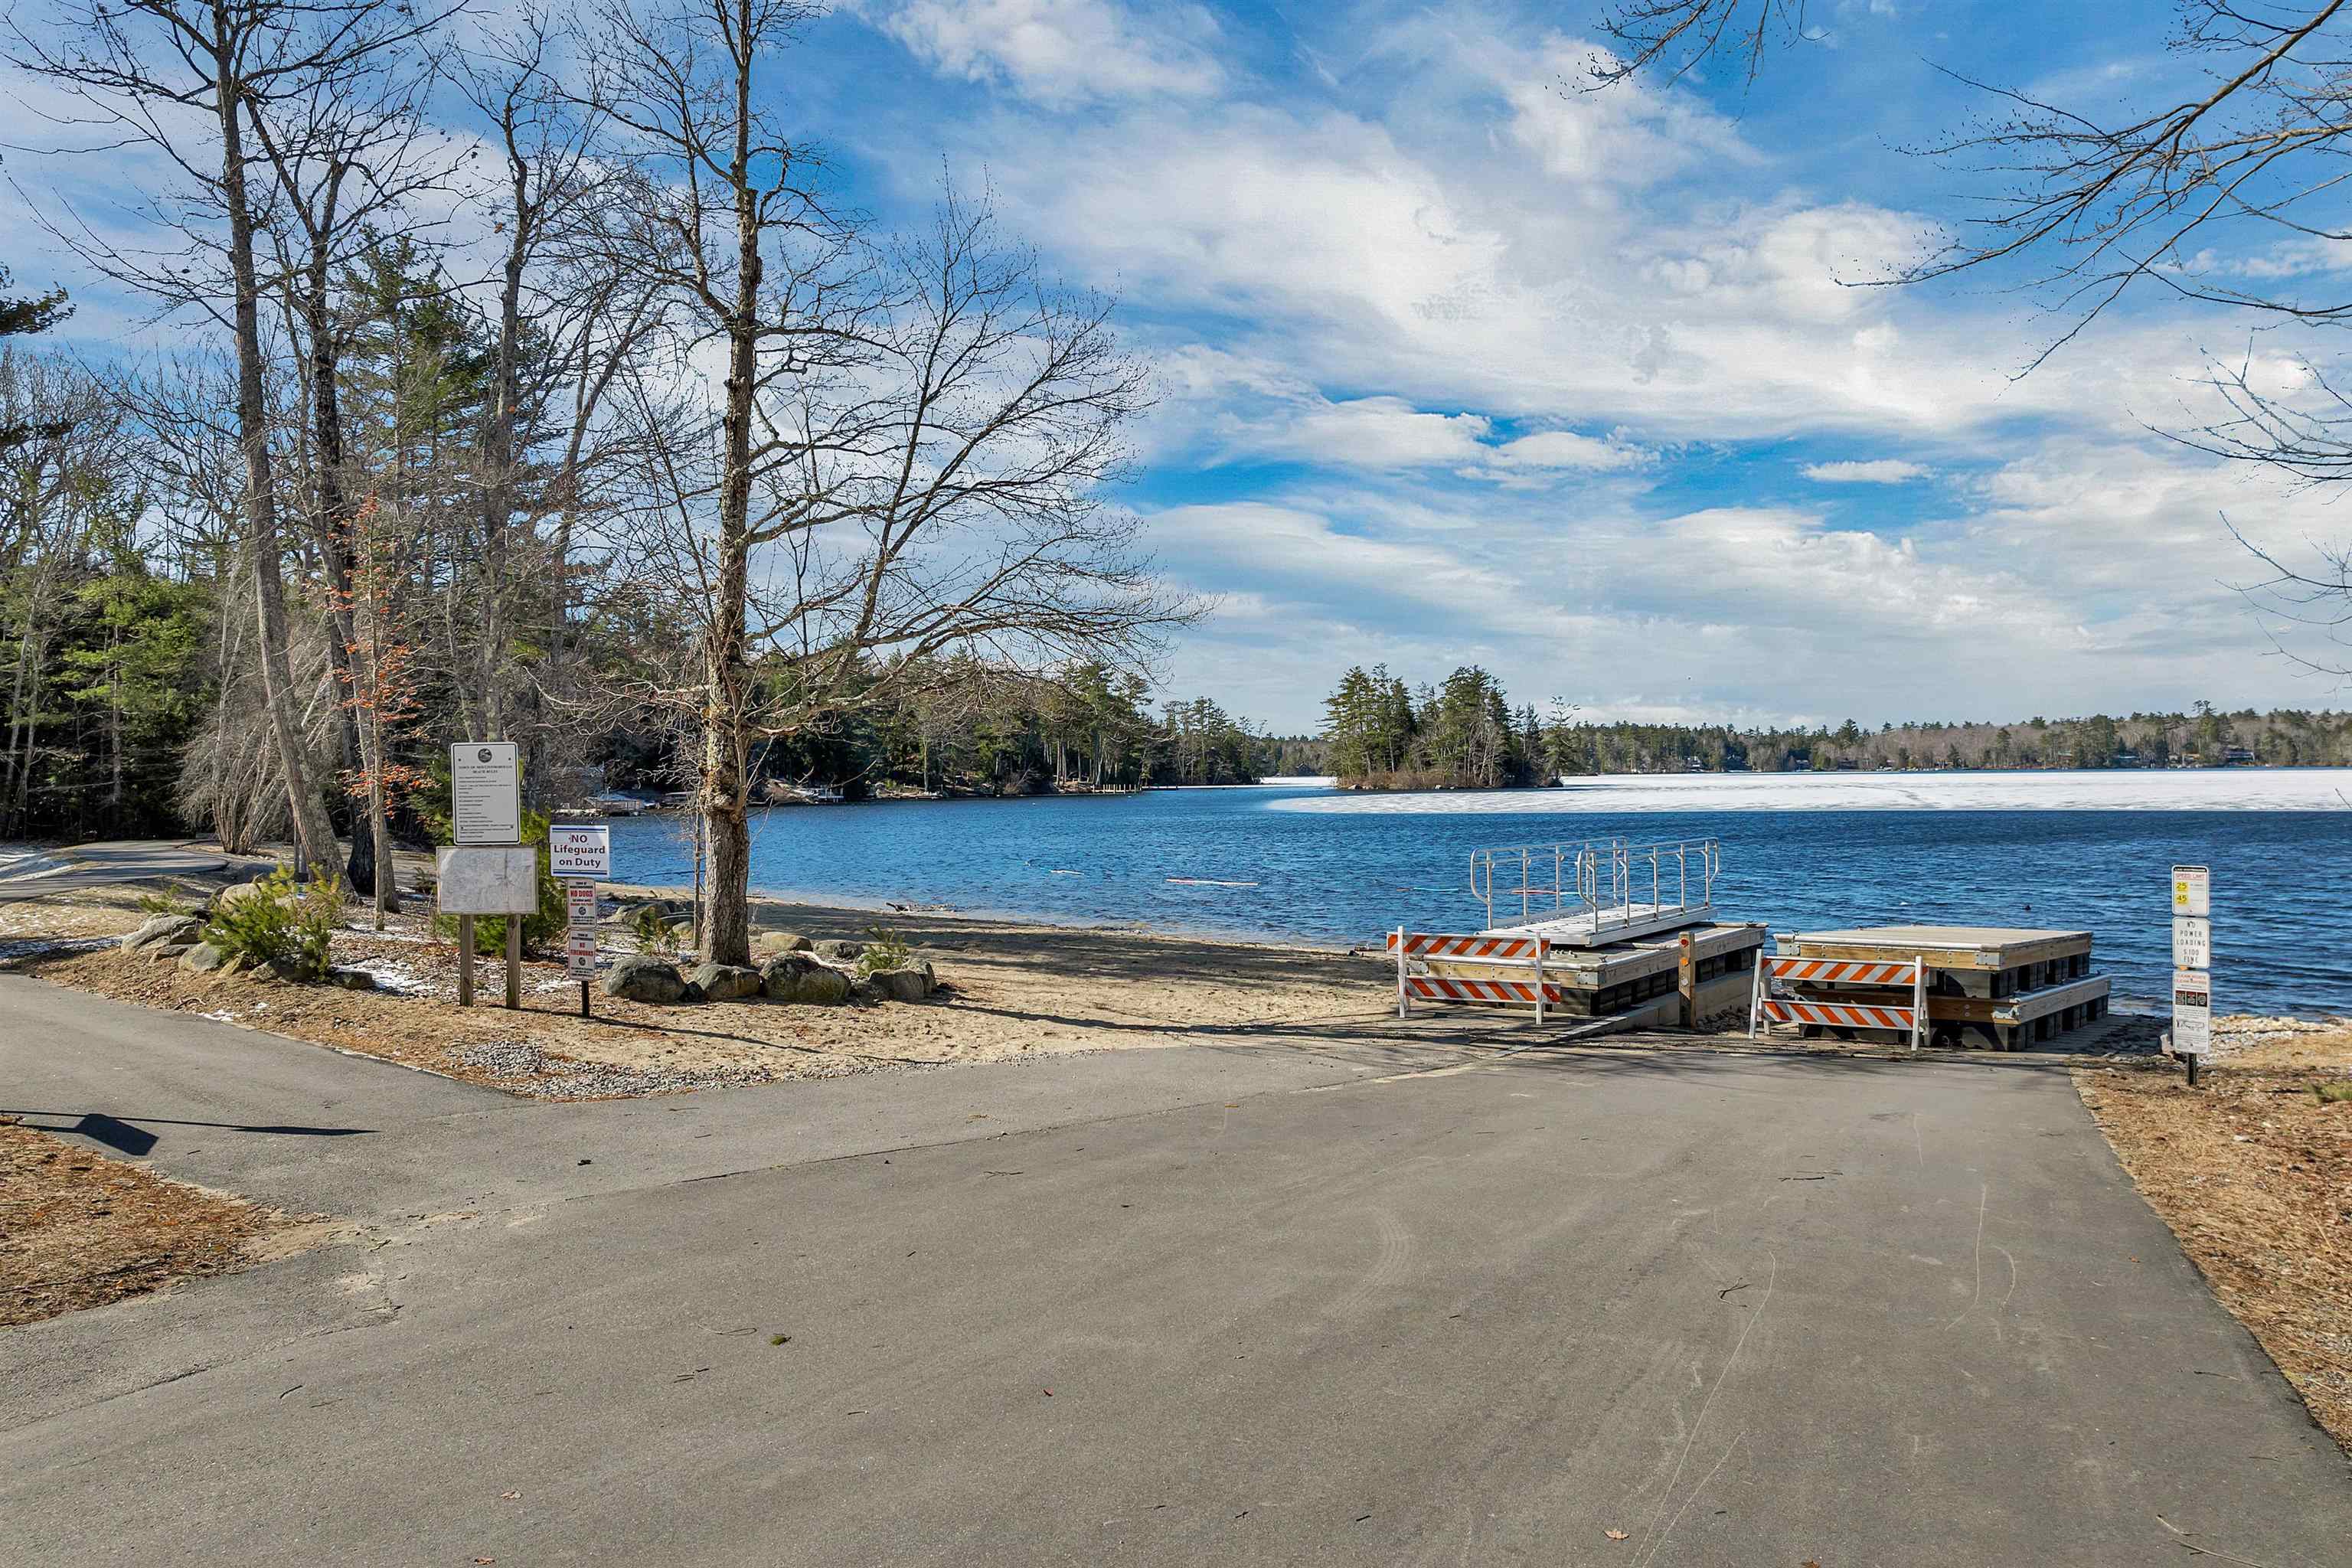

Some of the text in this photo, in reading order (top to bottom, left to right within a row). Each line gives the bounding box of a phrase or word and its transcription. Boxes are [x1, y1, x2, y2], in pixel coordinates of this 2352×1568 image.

[571, 835, 587, 843] NO
[554, 845, 606, 855] Lifeguard
[576, 858, 601, 868] Duty
